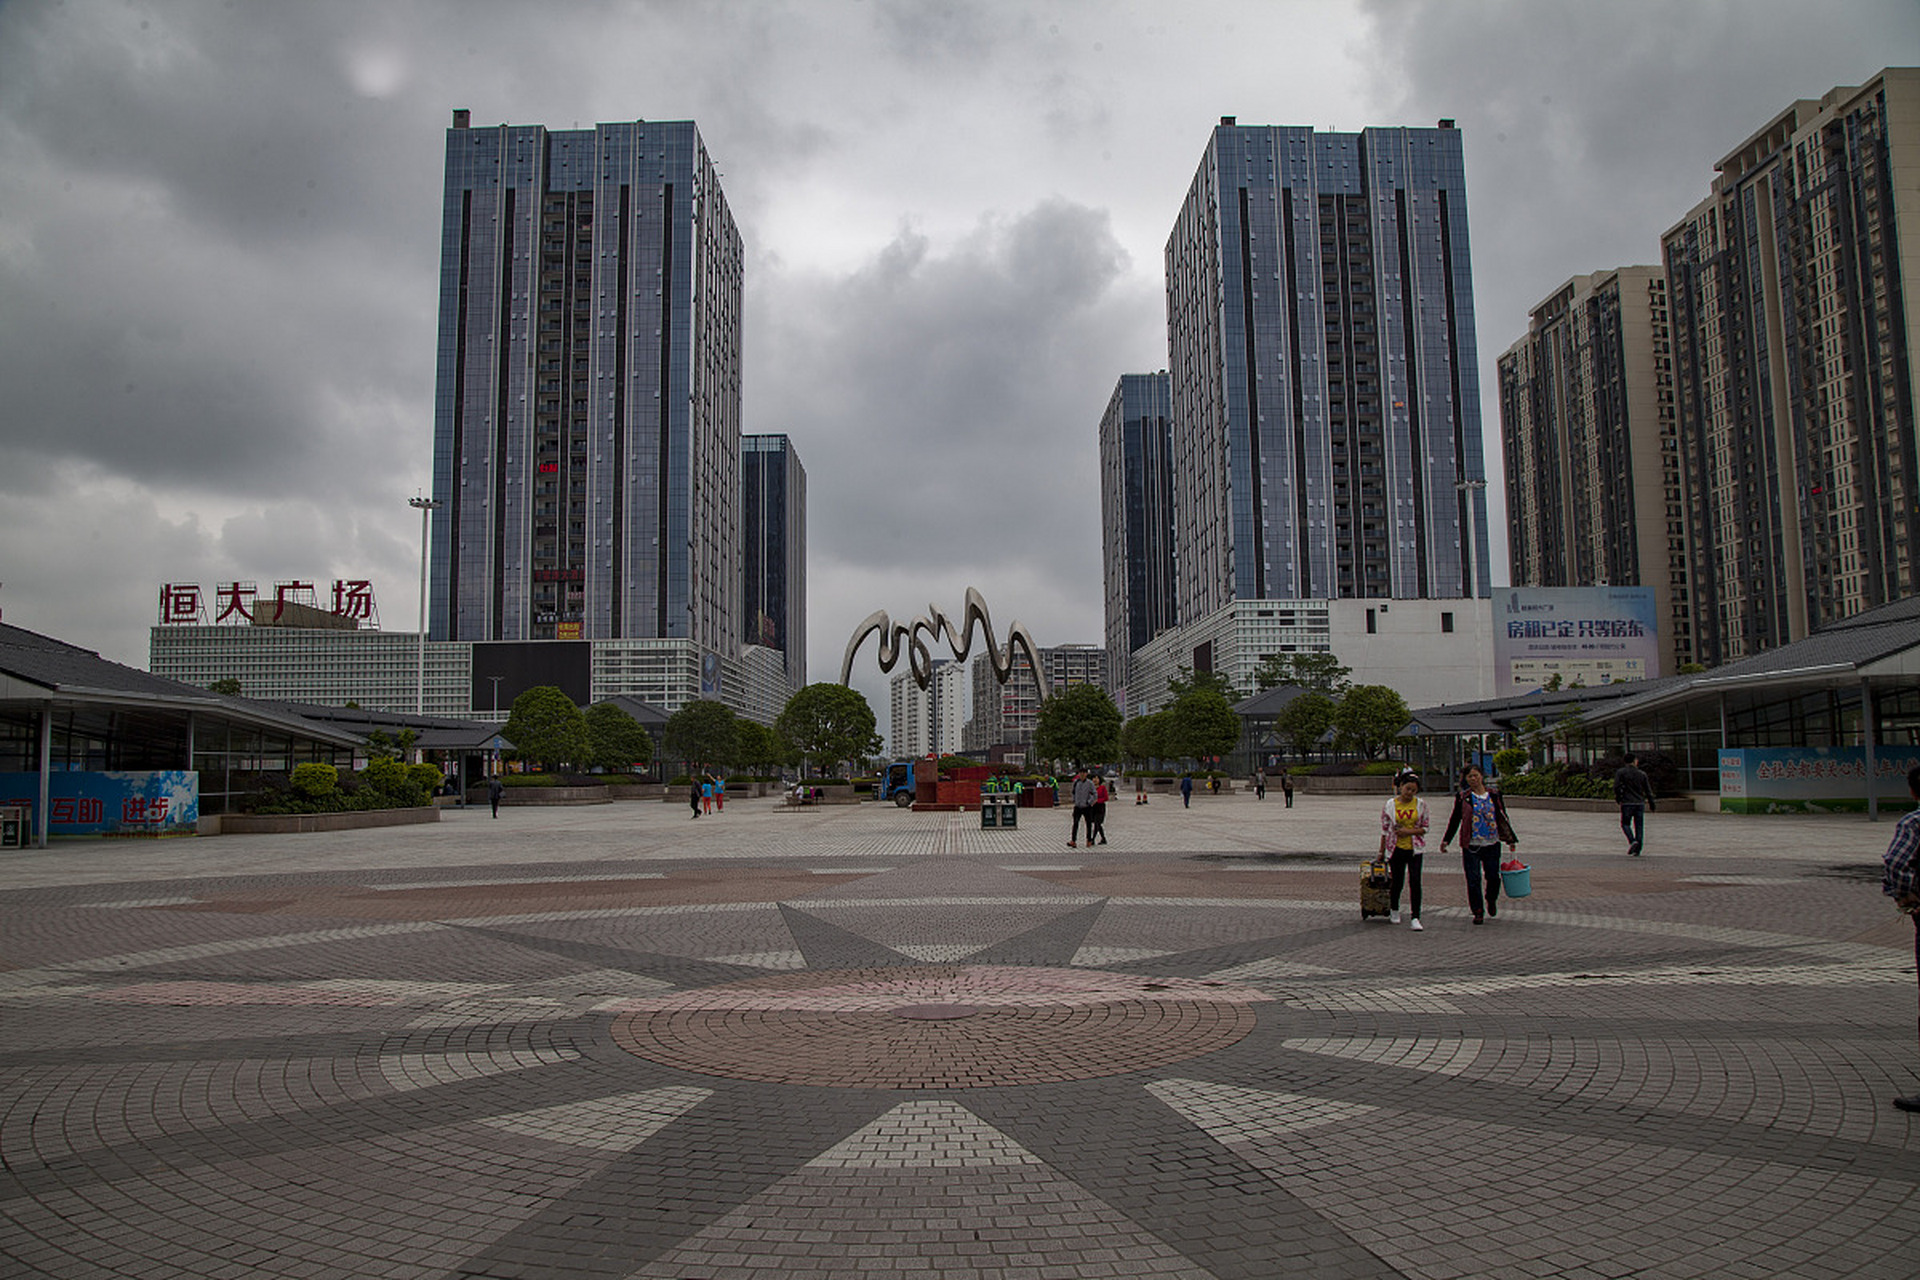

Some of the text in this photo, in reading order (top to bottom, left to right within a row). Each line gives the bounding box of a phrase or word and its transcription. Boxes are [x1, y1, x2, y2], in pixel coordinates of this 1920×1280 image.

[160, 580, 371, 623] 恒大广场
[1508, 620, 1644, 638] 房租已定 只等房东
[51, 797, 169, 824] 互助 进步
[1397, 809, 1414, 820] W
